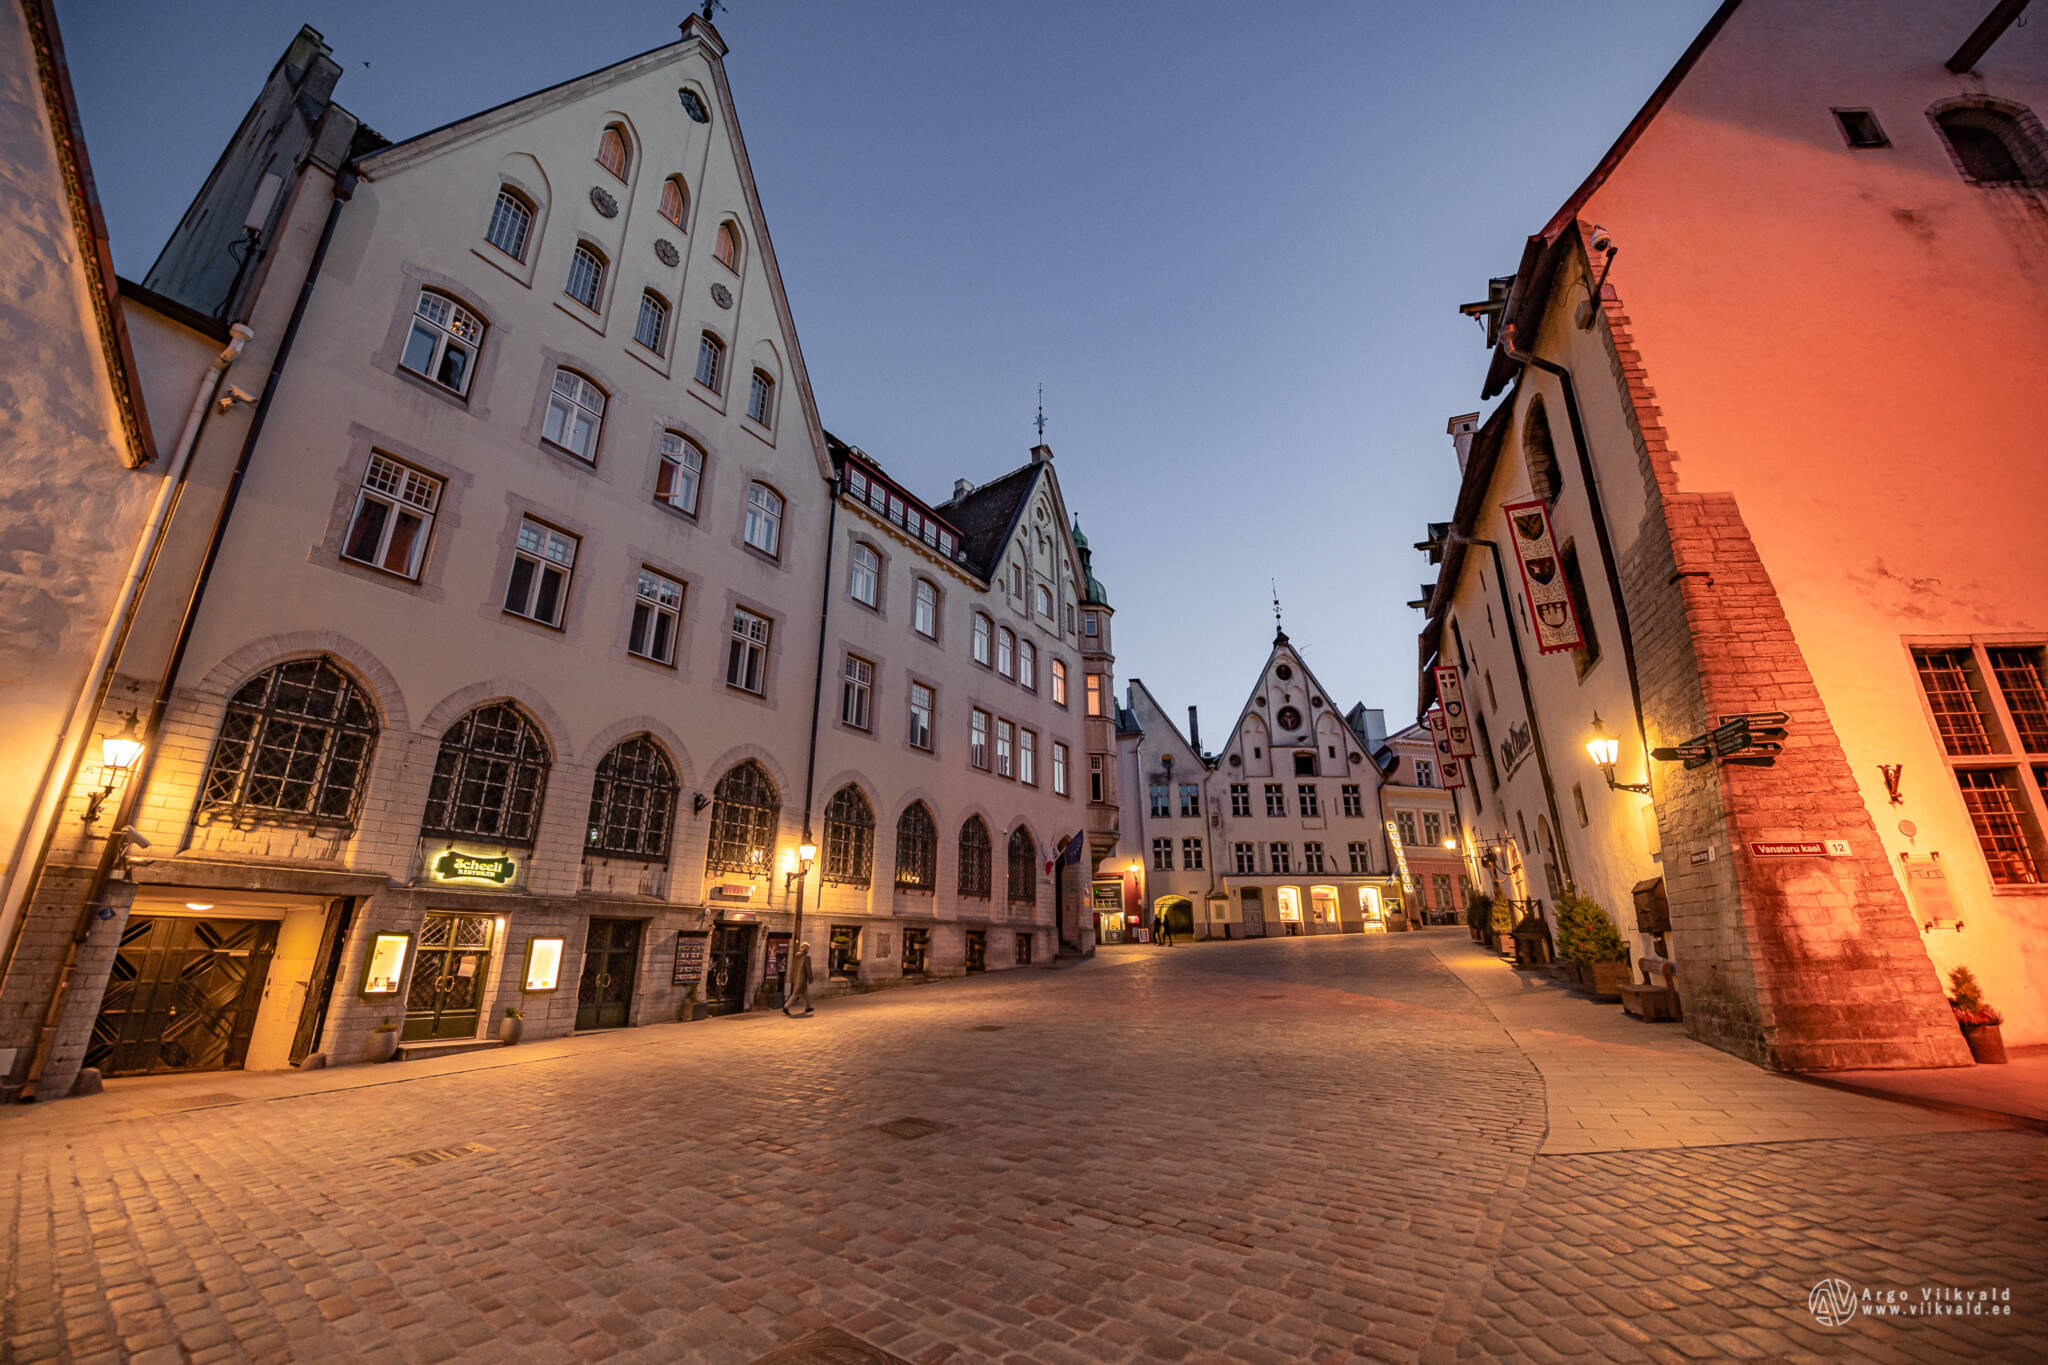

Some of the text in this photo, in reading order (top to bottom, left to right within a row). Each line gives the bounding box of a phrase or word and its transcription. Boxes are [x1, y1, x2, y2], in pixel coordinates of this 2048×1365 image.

[1757, 843, 1845, 854] Vanaturu kael 12
[453, 858, 503, 873] Scheeli
